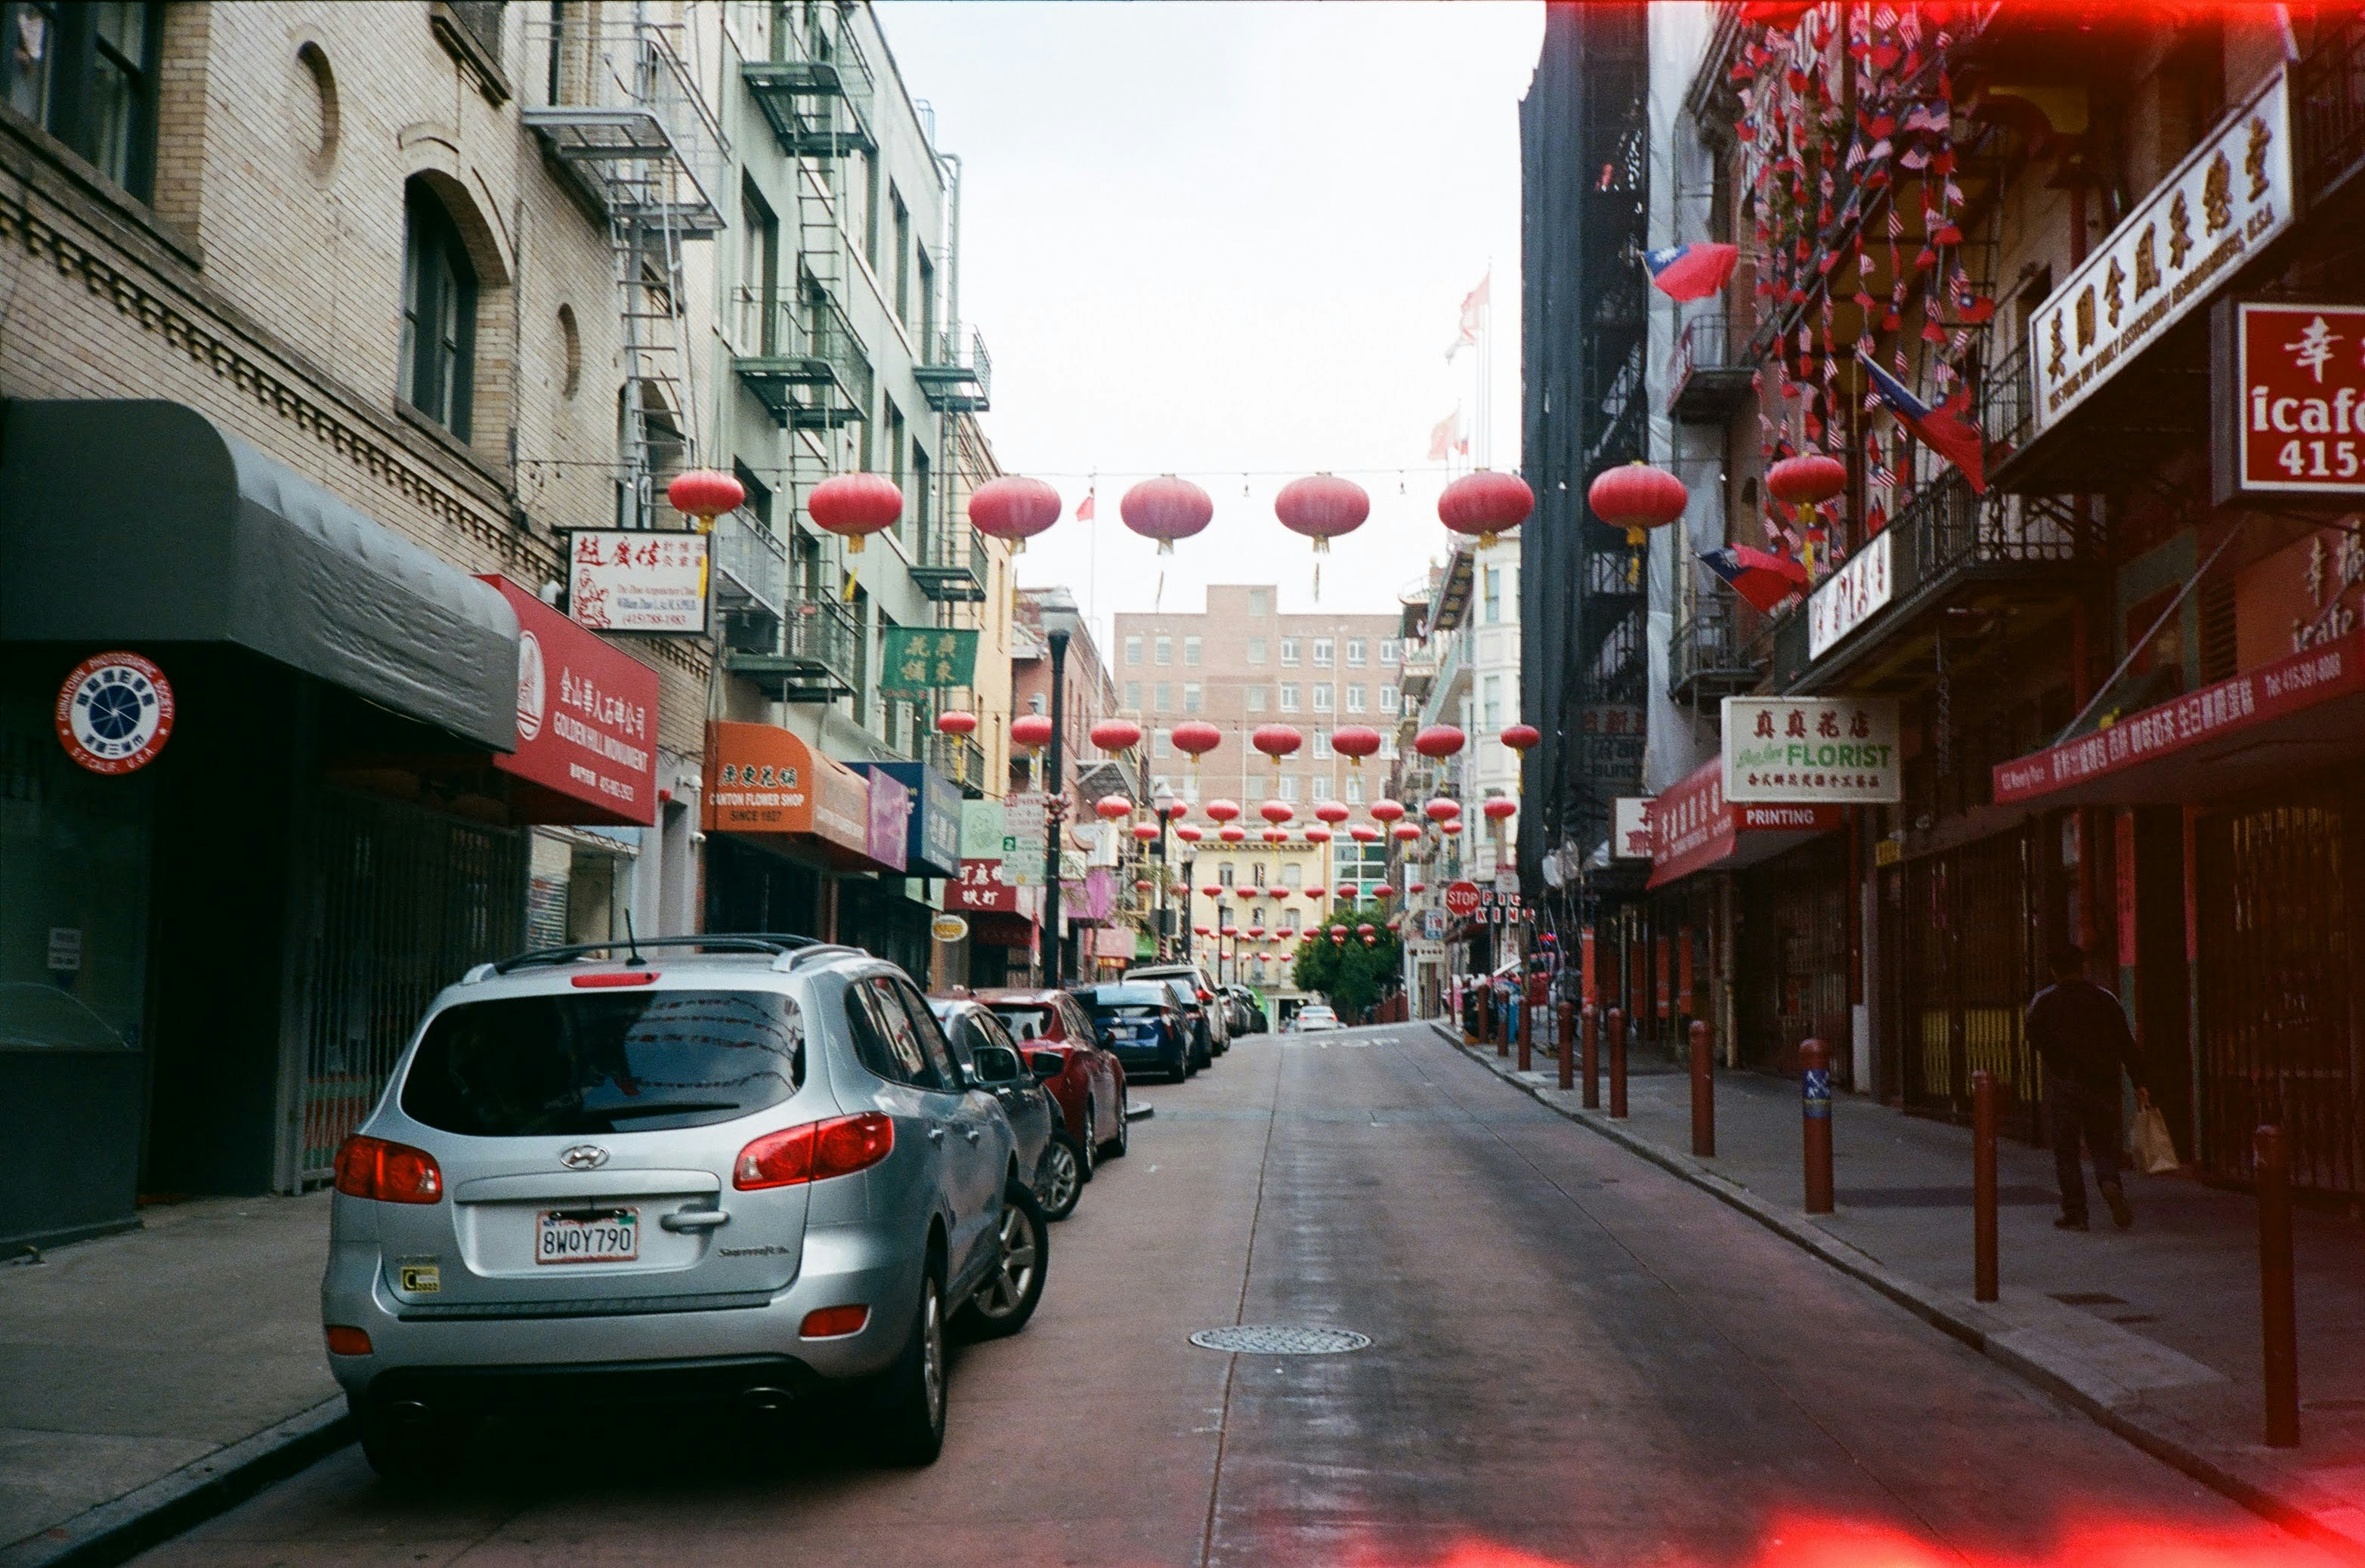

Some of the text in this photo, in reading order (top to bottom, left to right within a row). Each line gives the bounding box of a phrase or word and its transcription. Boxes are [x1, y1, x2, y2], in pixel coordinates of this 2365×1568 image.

[2278, 439, 2365, 478] 415
[56, 666, 86, 721] CHINATOWN
[1753, 709, 1870, 739] 真真花店
[607, 735, 648, 773] MONUMENT
[1786, 744, 1890, 769] FLORIST
[709, 793, 805, 806] CANTON FLOWER SHOP
[730, 810, 758, 821] SINCE
[1746, 809, 1815, 825] PRINTING
[1448, 891, 1479, 907] STOP
[543, 1228, 631, 1254] 8WQY790
